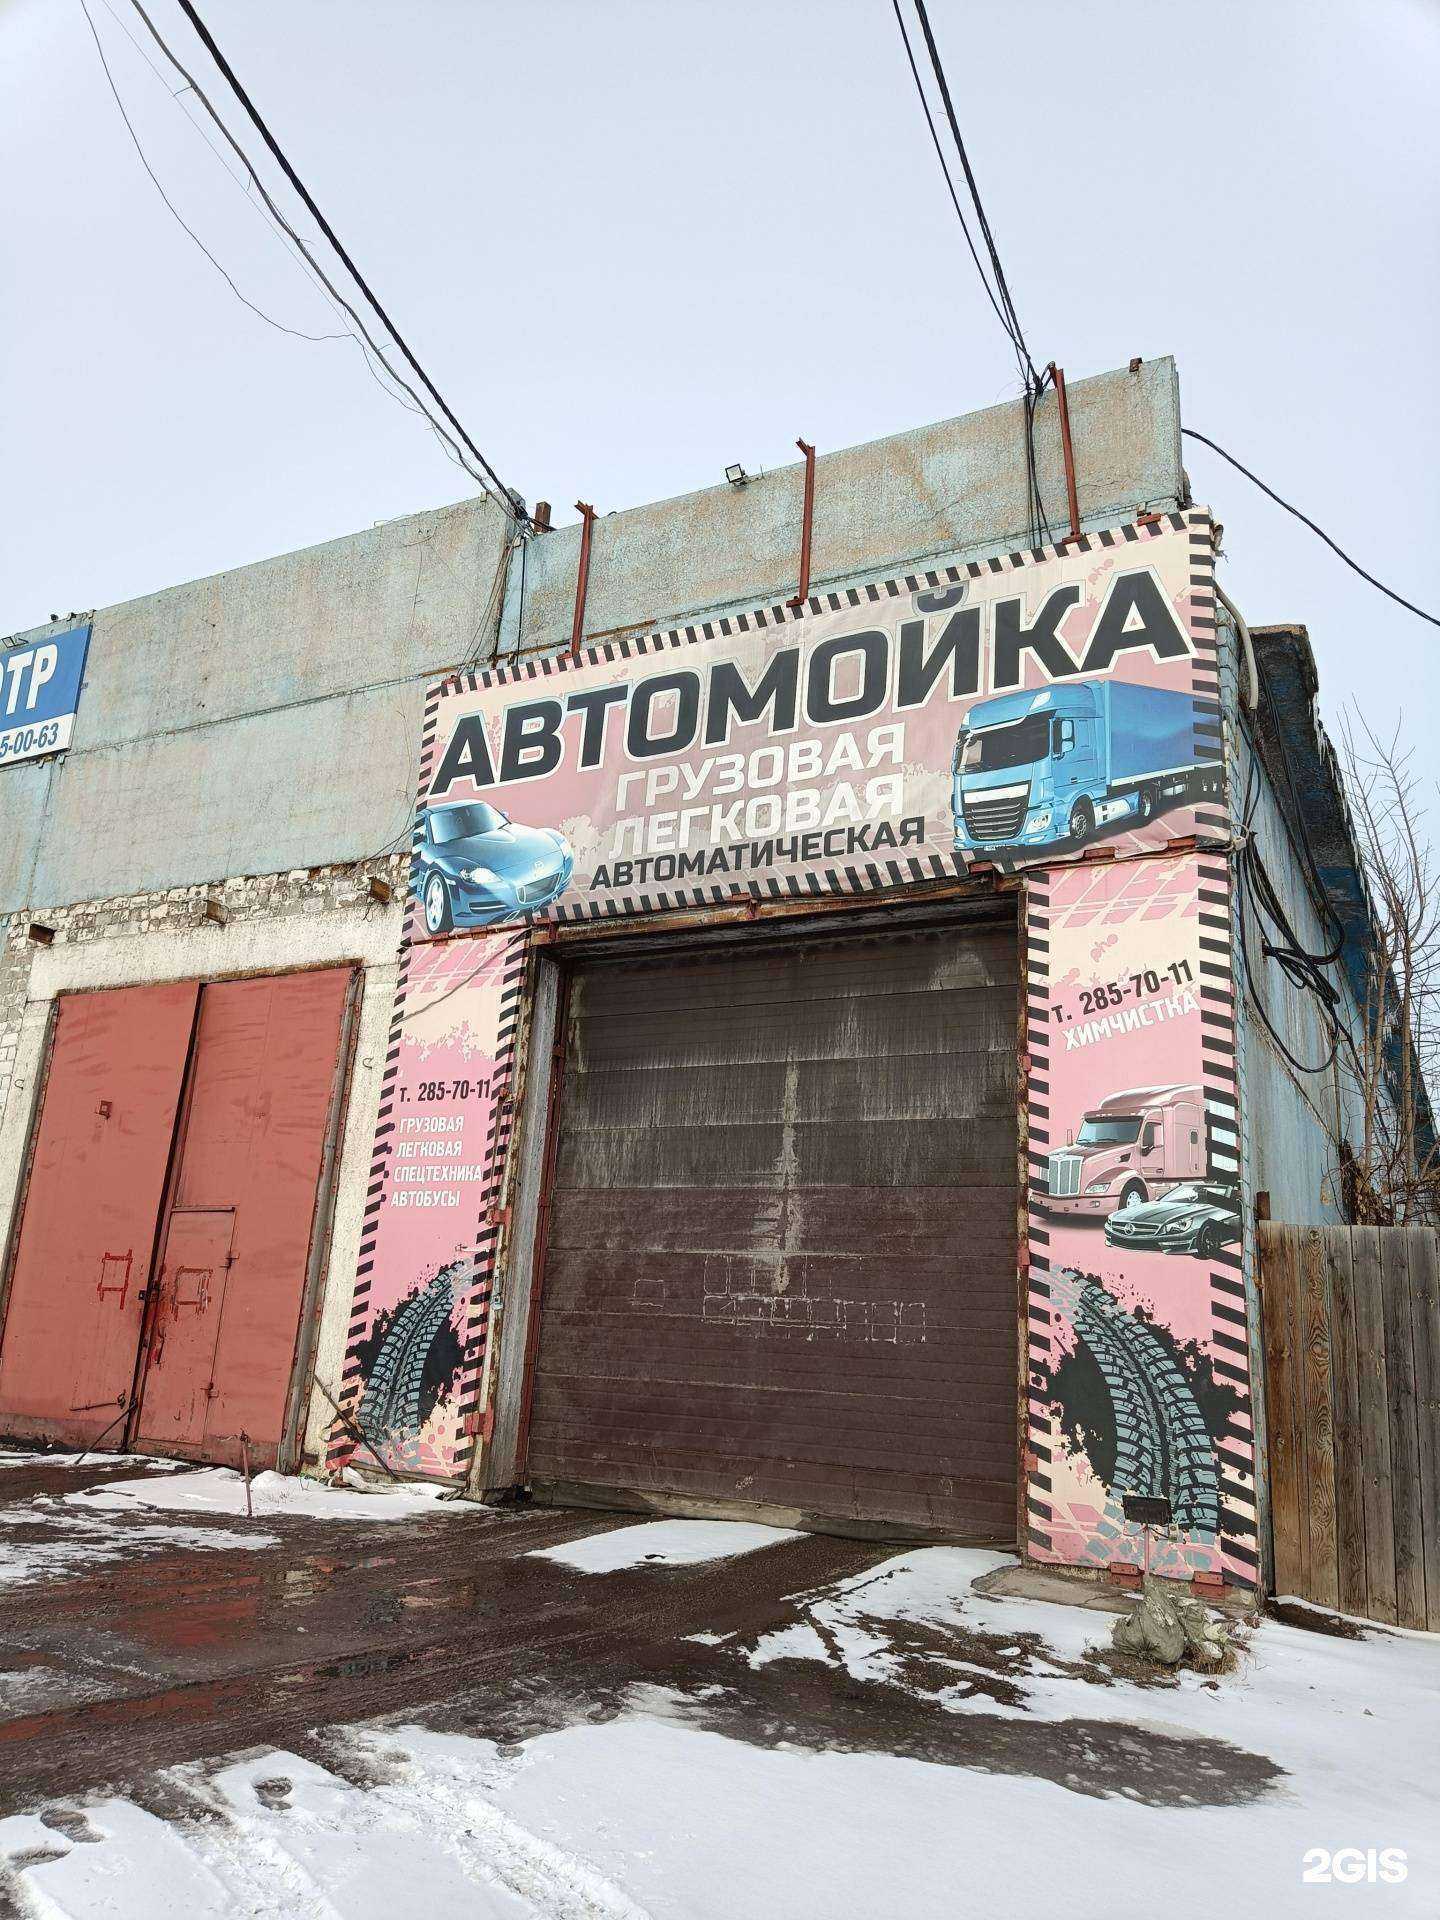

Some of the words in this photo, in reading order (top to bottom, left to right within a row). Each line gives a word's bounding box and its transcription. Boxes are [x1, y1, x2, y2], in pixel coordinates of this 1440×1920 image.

[0, 644, 58, 716] ТР
[428, 568, 1194, 797] АВТОМОЙКА
[615, 723, 905, 812] ГРУЗОВАЯ
[608, 773, 904, 860] ЛЕГКОВАЯ
[589, 816, 925, 890] АВТОМАТИЧЕСКАЯ
[1078, 959, 1193, 1015] 285-70-11
[1062, 991, 1201, 1051] ХИМЧИСТКА
[418, 1079, 491, 1101] 285-70-11
[397, 1140, 463, 1158] ЛЕГКОВАЯ
[400, 1115, 464, 1134] ГРУЗОВАЯ
[391, 1190, 460, 1207] АВТОБУСЫ
[394, 1165, 483, 1184] СПЕЦТЕХНИКА
